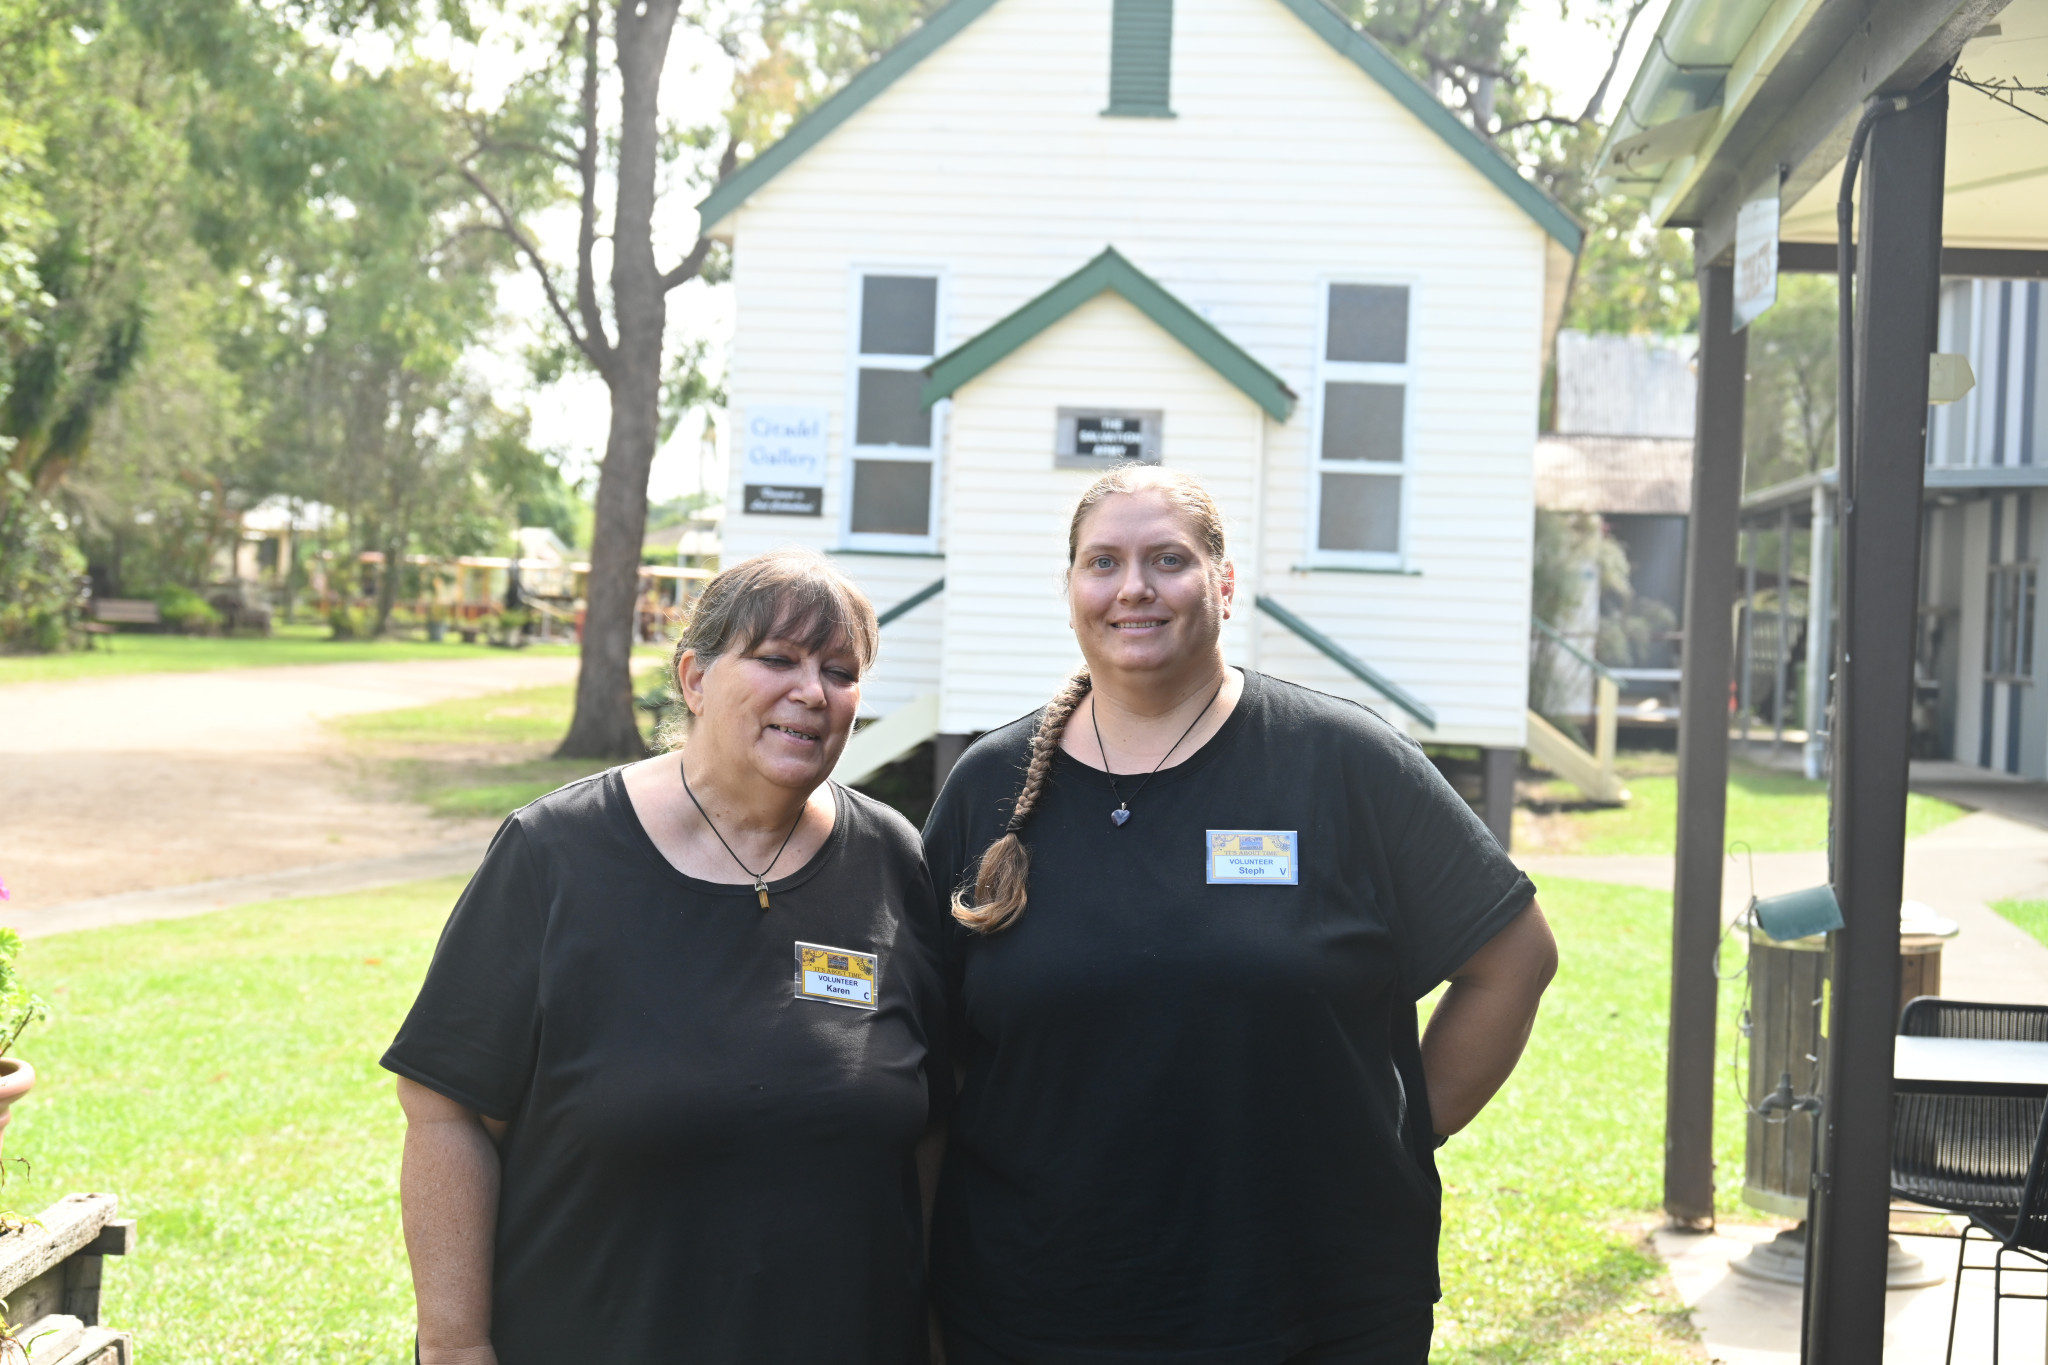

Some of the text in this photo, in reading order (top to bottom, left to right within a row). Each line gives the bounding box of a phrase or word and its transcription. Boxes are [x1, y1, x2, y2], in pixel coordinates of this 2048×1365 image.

[1101, 418, 1124, 430] THE
[1079, 429, 1143, 444] SALVATION
[749, 445, 817, 474] Gallery
[1239, 867, 1287, 876] Steph V
[827, 969, 846, 977] ABOUT
[818, 975, 858, 987] VOLUNTEER
[826, 985, 870, 1000] Karen C
